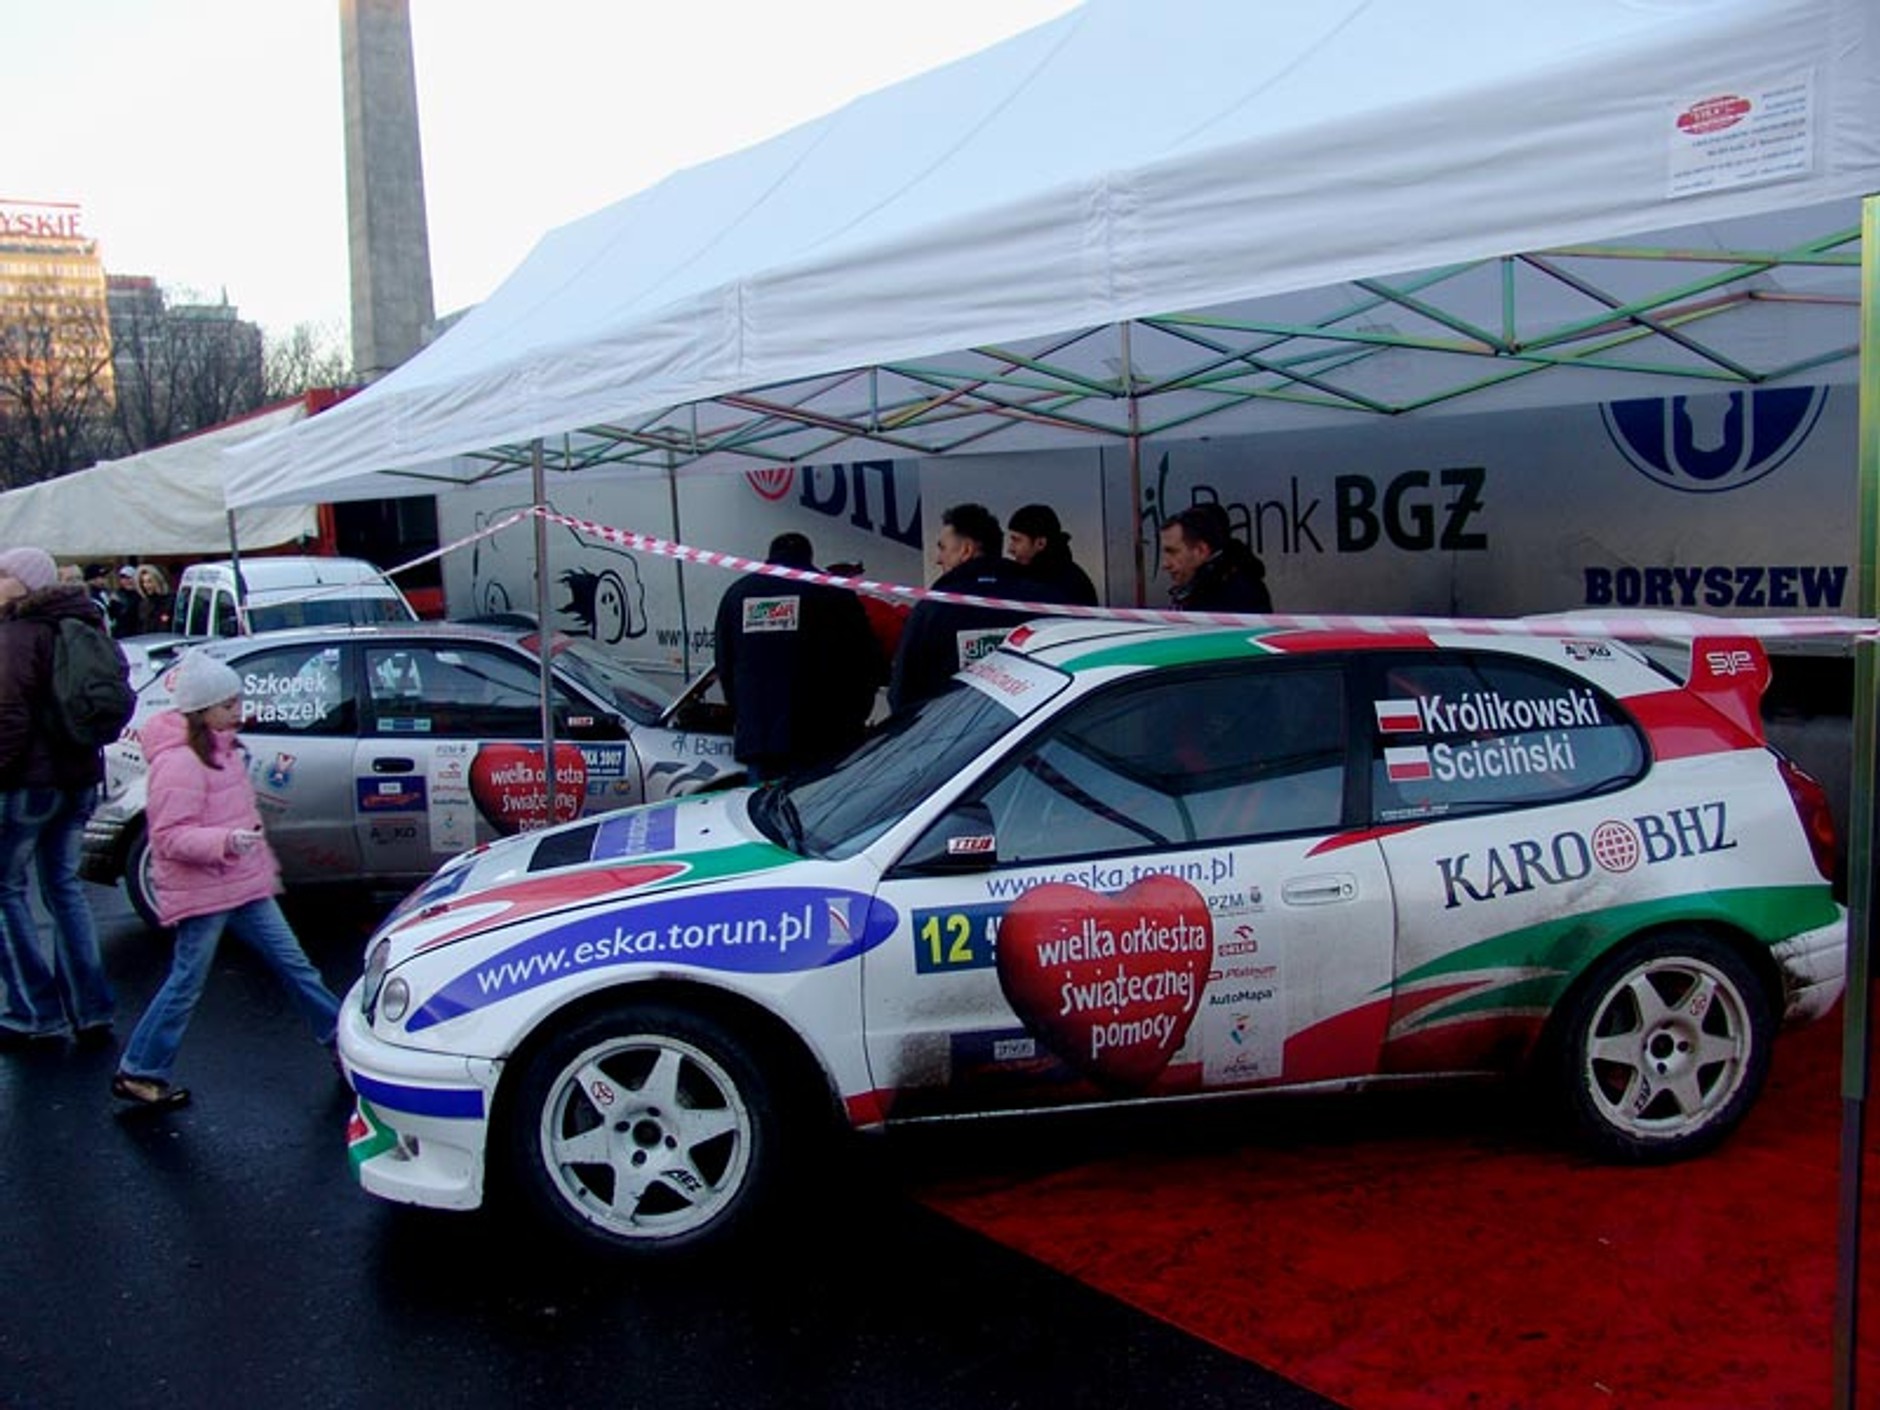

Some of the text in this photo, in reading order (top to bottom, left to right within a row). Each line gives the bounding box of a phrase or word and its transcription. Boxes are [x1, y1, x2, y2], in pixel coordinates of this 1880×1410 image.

[1584, 566, 1848, 608] BORYSZEW
[243, 672, 327, 697] Szkopek
[241, 698, 328, 723] Ptaszek
[1419, 689, 1601, 733] Królikowski
[491, 762, 535, 786] wielka
[1433, 733, 1576, 781] Sciciński
[1436, 802, 1738, 908] KARO BHZ
[476, 905, 813, 994] www.eska.torun.pl
[921, 914, 973, 965] 12
[1036, 914, 1206, 968] wielka orkiestra
[1060, 960, 1194, 1016] świątecznej
[1209, 987, 1274, 1006] AutoMapa
[1091, 1013, 1177, 1060] pomocy
